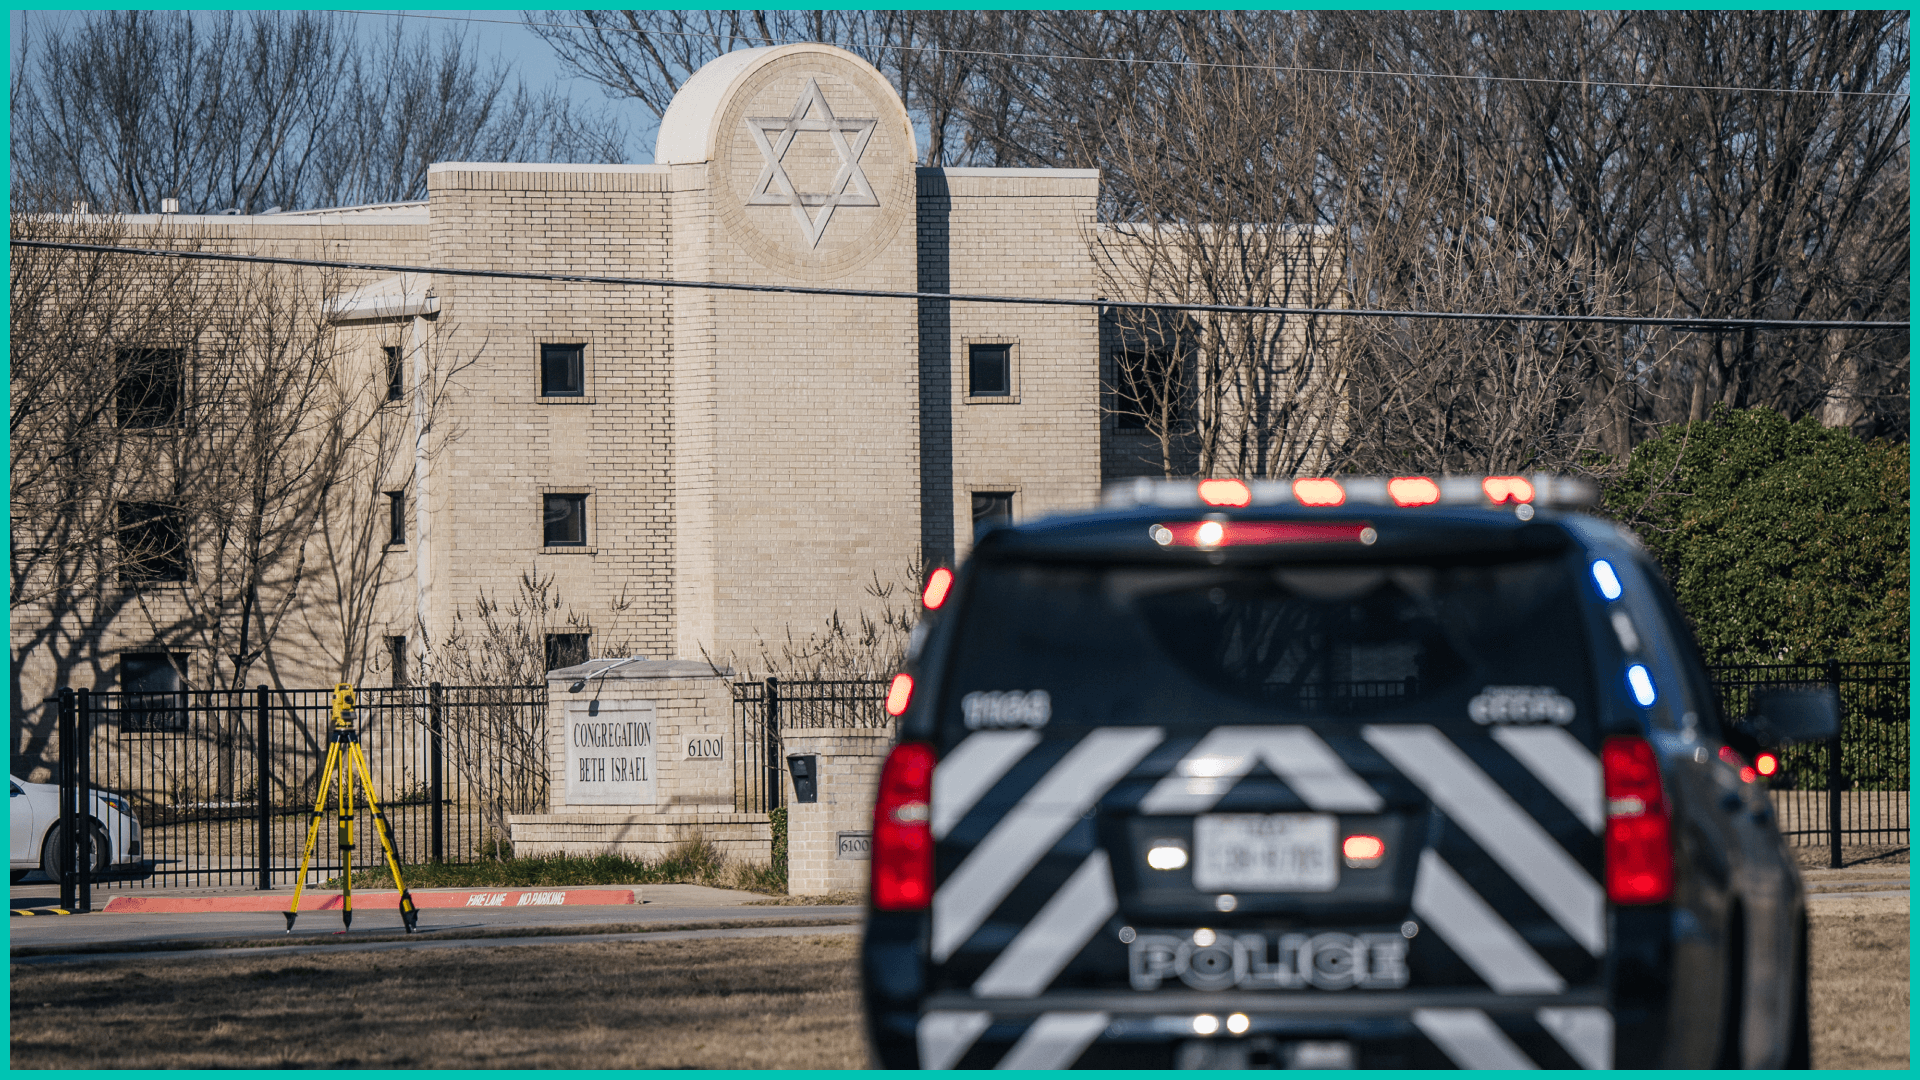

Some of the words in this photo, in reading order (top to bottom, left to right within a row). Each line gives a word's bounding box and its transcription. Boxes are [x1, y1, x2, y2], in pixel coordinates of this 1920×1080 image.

[573, 721, 651, 748] CONGREGATION
[688, 738, 721, 757] 6100
[579, 757, 606, 782] BETH
[611, 756, 648, 782] ISRAEL
[841, 839, 870, 852] 6100
[466, 893, 487, 907] FIRE
[484, 892, 507, 907] LANE
[517, 892, 532, 906] NO
[530, 891, 566, 906] PARKING
[1128, 932, 1410, 991] POLICE
